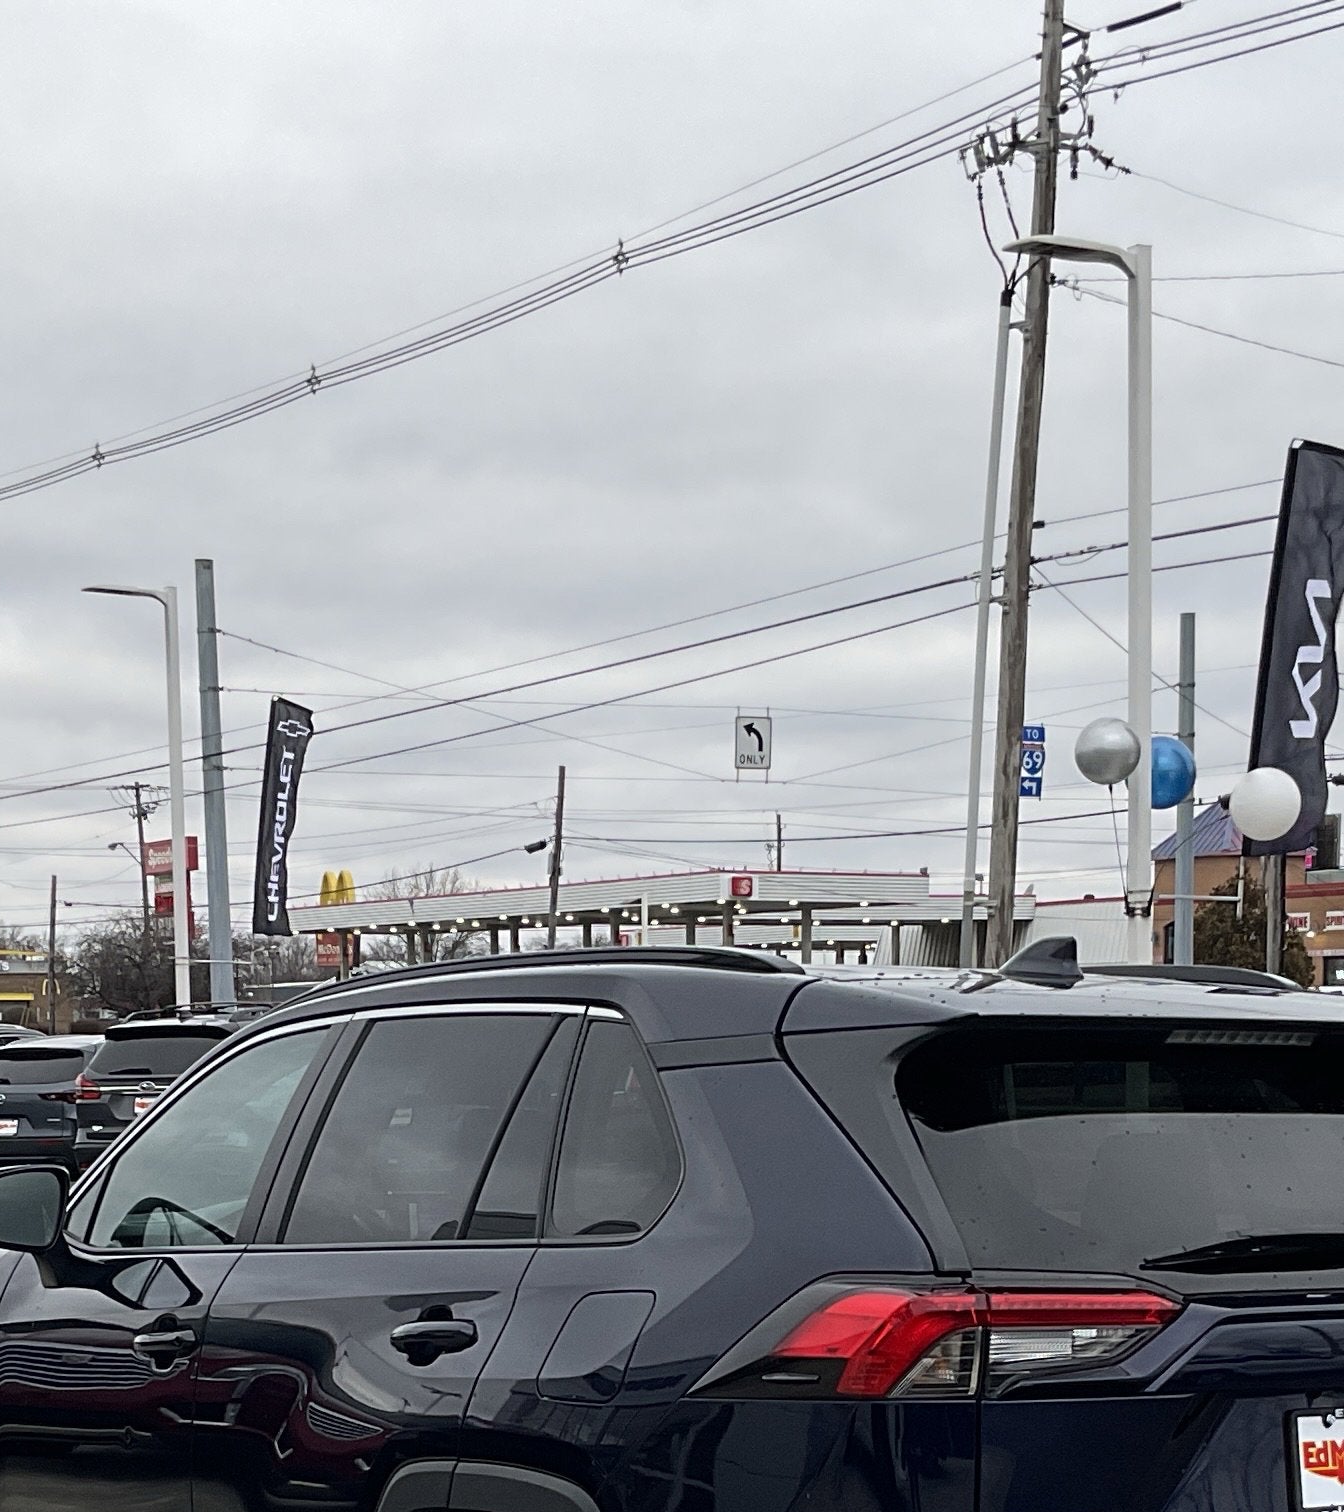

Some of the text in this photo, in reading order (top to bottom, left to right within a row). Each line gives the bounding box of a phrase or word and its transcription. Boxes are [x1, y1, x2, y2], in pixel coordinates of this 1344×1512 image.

[1026, 729, 1039, 739] TO
[739, 754, 765, 764] ONLY
[1022, 751, 1043, 769] 69
[267, 745, 296, 922] CHEVROLET
